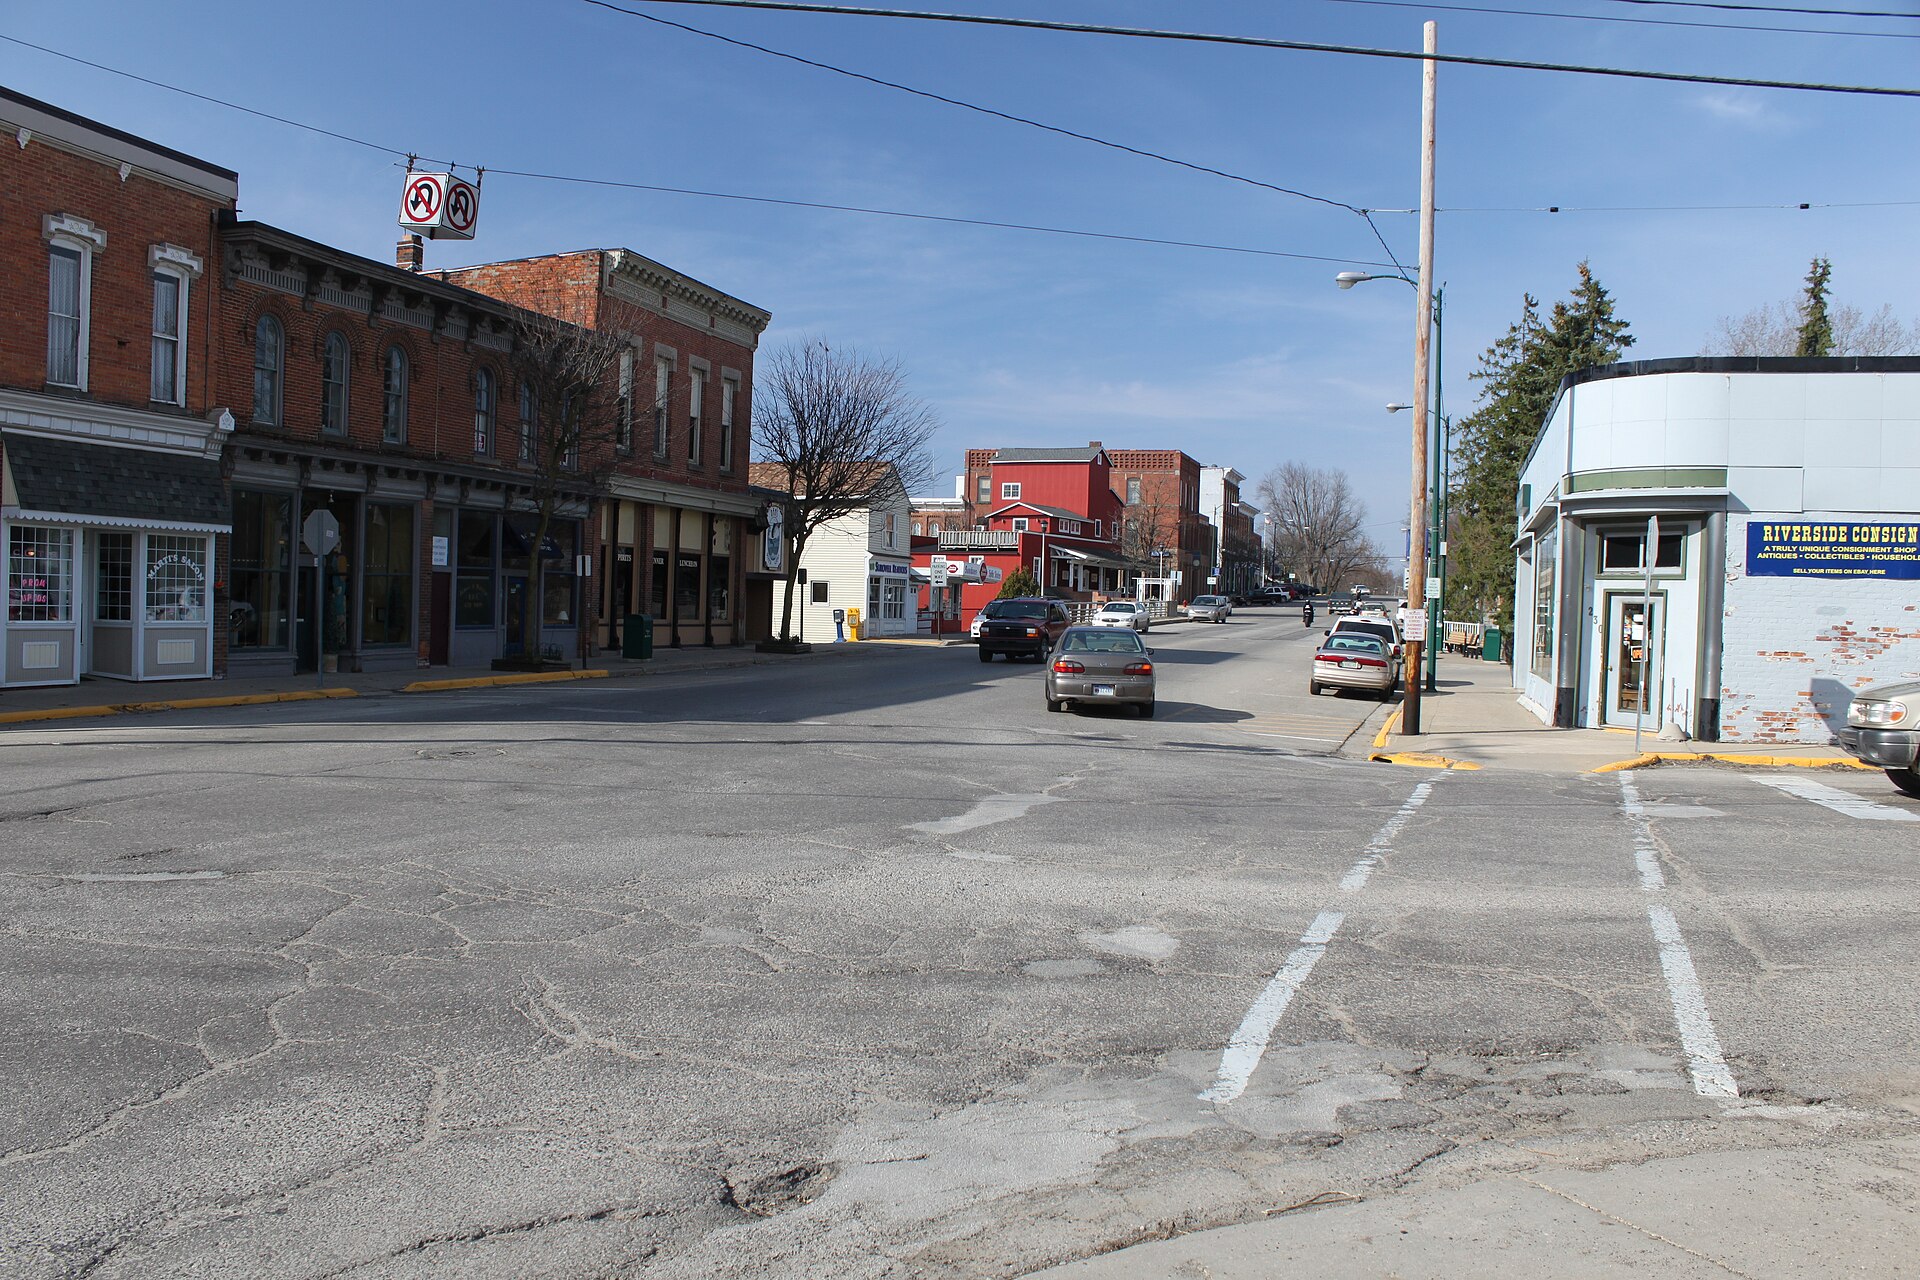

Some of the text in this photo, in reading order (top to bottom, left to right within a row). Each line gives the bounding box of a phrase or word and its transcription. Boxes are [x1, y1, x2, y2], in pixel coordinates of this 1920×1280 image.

[1763, 525, 1918, 543] RIVERSIDE CONSIGN
[1799, 545, 1830, 553] UNIQUE
[617, 554, 632, 562] PIRITS
[1757, 552, 1798, 560] ANTIQUES
[148, 554, 204, 581] MARTI'S SALON
[22, 578, 47, 588] PROM
